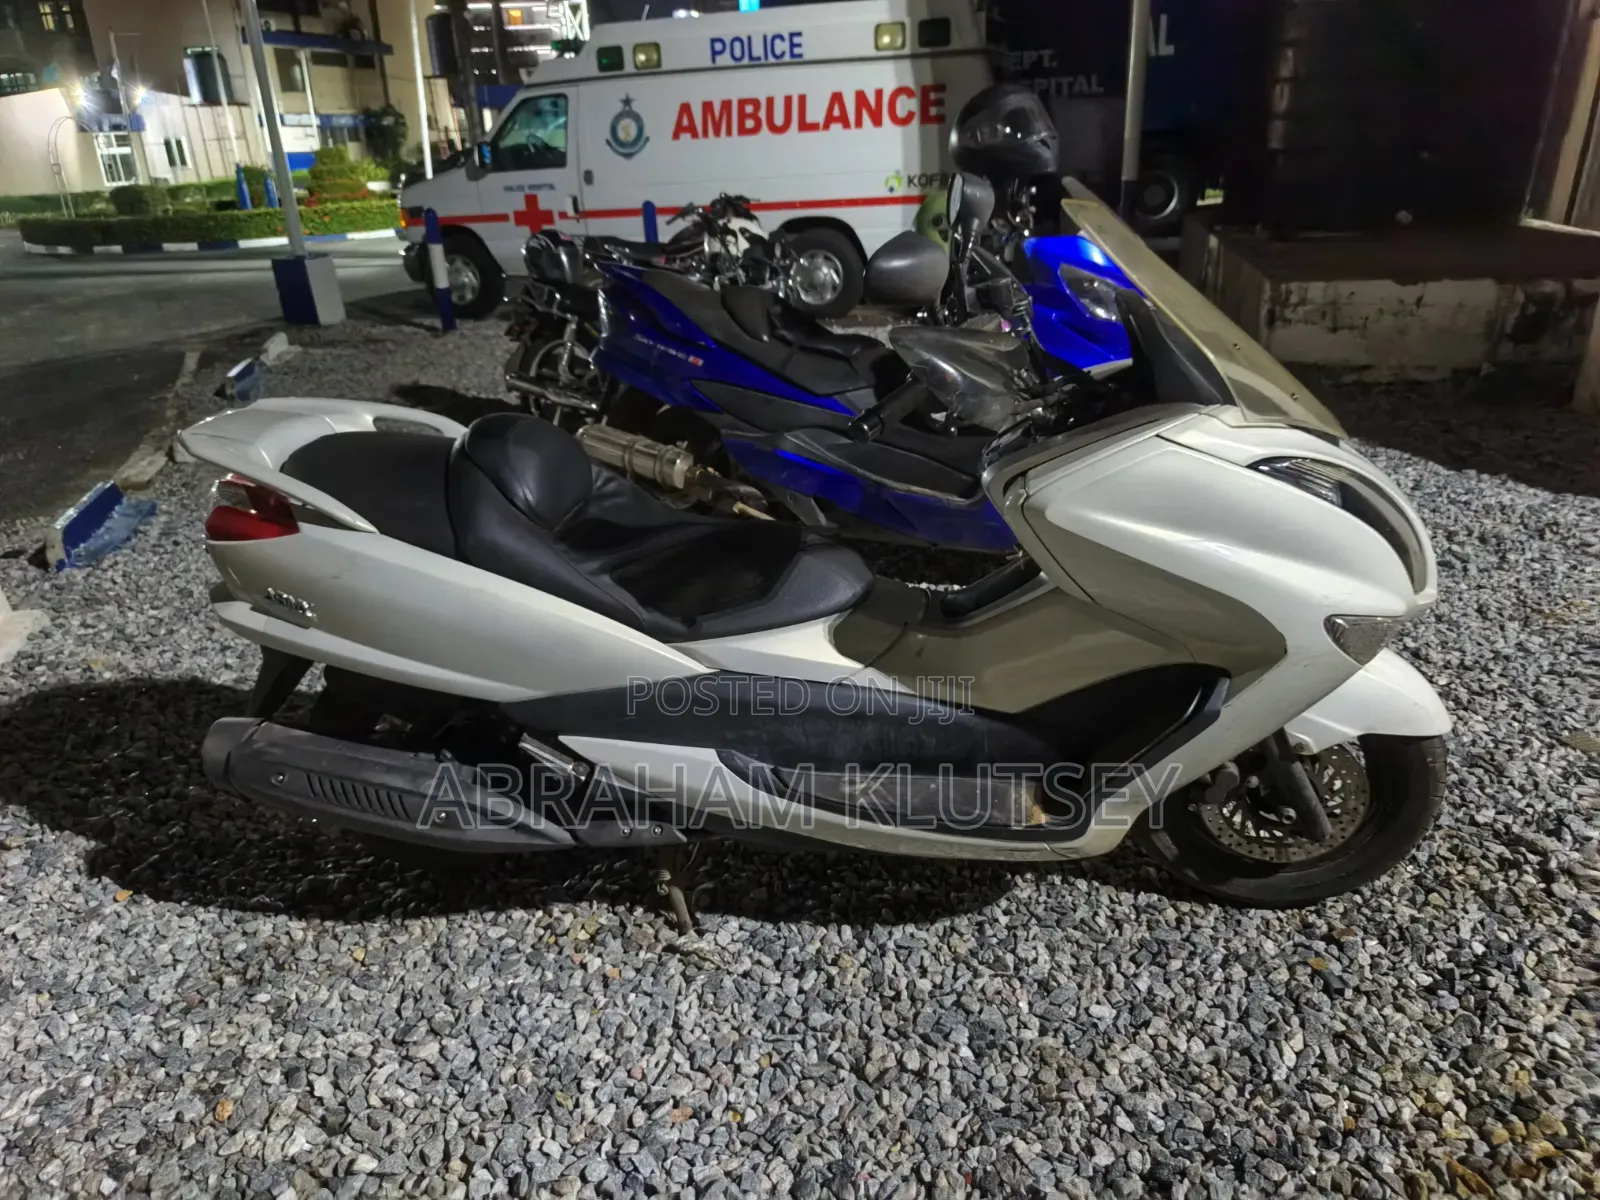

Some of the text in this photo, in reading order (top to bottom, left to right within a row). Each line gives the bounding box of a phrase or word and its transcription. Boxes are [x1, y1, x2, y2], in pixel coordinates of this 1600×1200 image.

[709, 32, 804, 64] POLICE
[1008, 49, 1058, 70] EPT.
[1019, 73, 1105, 98] PITAL
[672, 83, 947, 141] AMBULANCE
